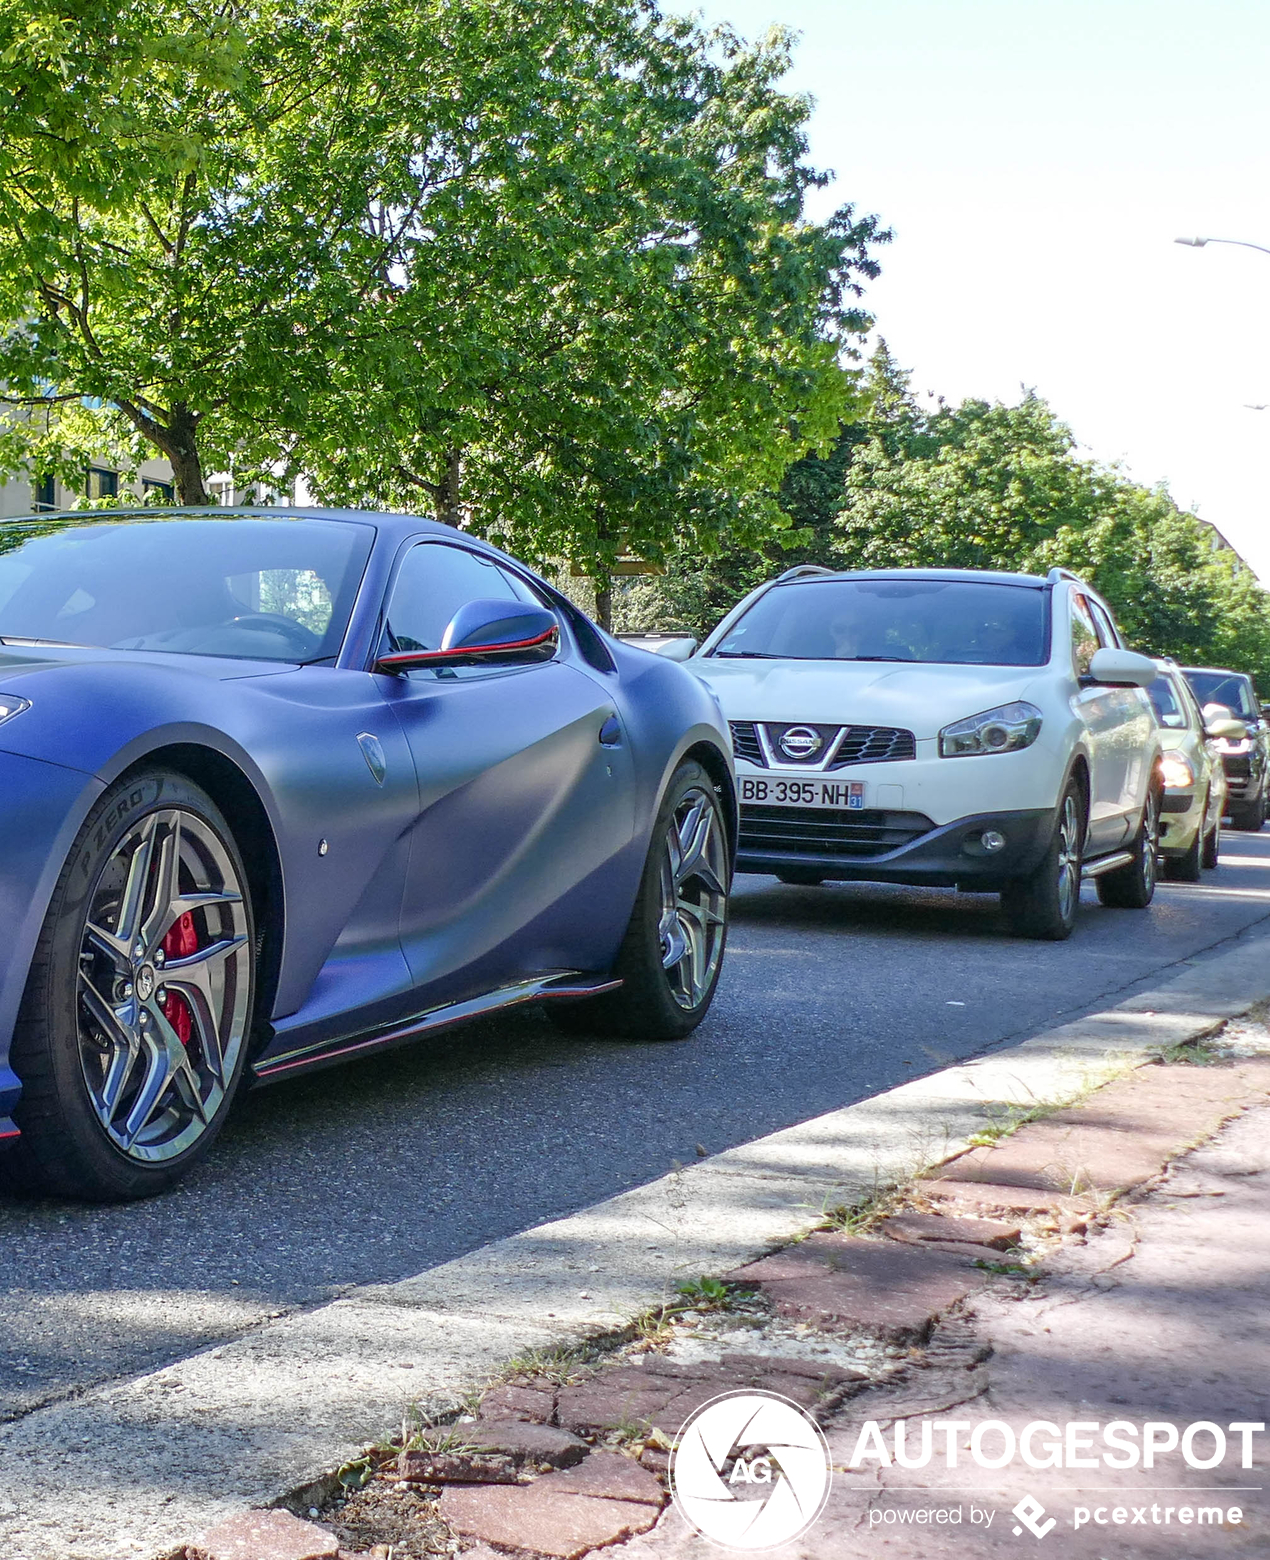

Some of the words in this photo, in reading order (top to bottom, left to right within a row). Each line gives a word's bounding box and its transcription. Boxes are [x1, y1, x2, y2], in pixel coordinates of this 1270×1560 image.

[784, 738, 815, 746] NISSAN
[743, 780, 849, 806] BB-395-NH
[850, 796, 863, 808] 31
[93, 789, 143, 851] ZERO
